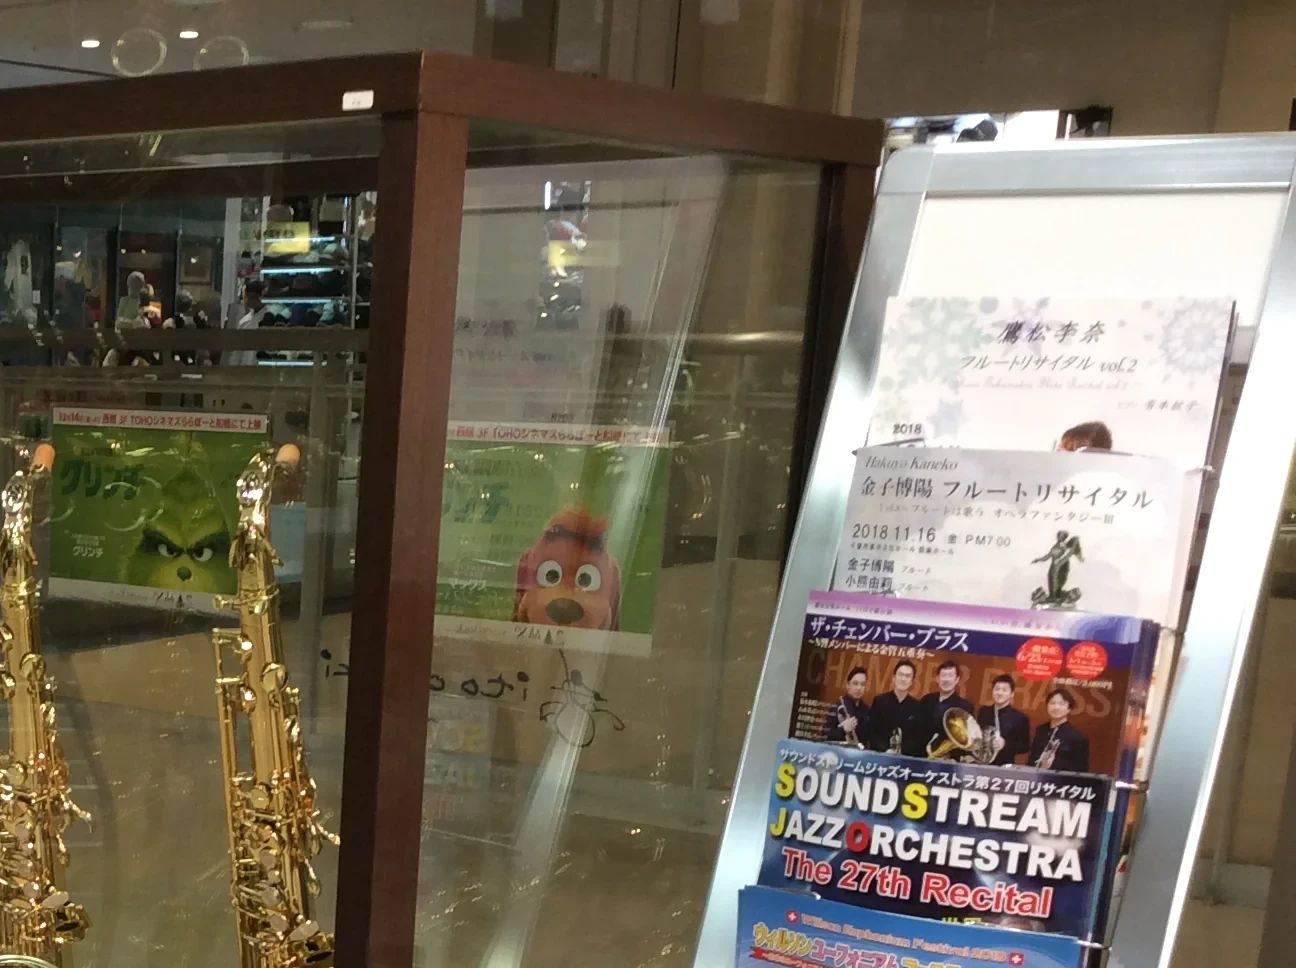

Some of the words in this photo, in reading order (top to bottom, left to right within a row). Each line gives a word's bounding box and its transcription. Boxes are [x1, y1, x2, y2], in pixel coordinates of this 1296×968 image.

[960, 354, 1093, 372] フルートリサイタル
[893, 423, 923, 435] 2018
[910, 457, 959, 471] Kaneko
[861, 475, 934, 498] 金子博陽
[943, 481, 1154, 510] フルートリサイタル
[847, 558, 895, 573] 金子博陽
[811, 616, 969, 652] ザ・チェンバー・ブラス
[781, 848, 833, 885] The
[837, 860, 910, 900] 27th
[919, 872, 1054, 918] Recital
[843, 924, 911, 948] Euphonium
[912, 937, 970, 956] Festival
